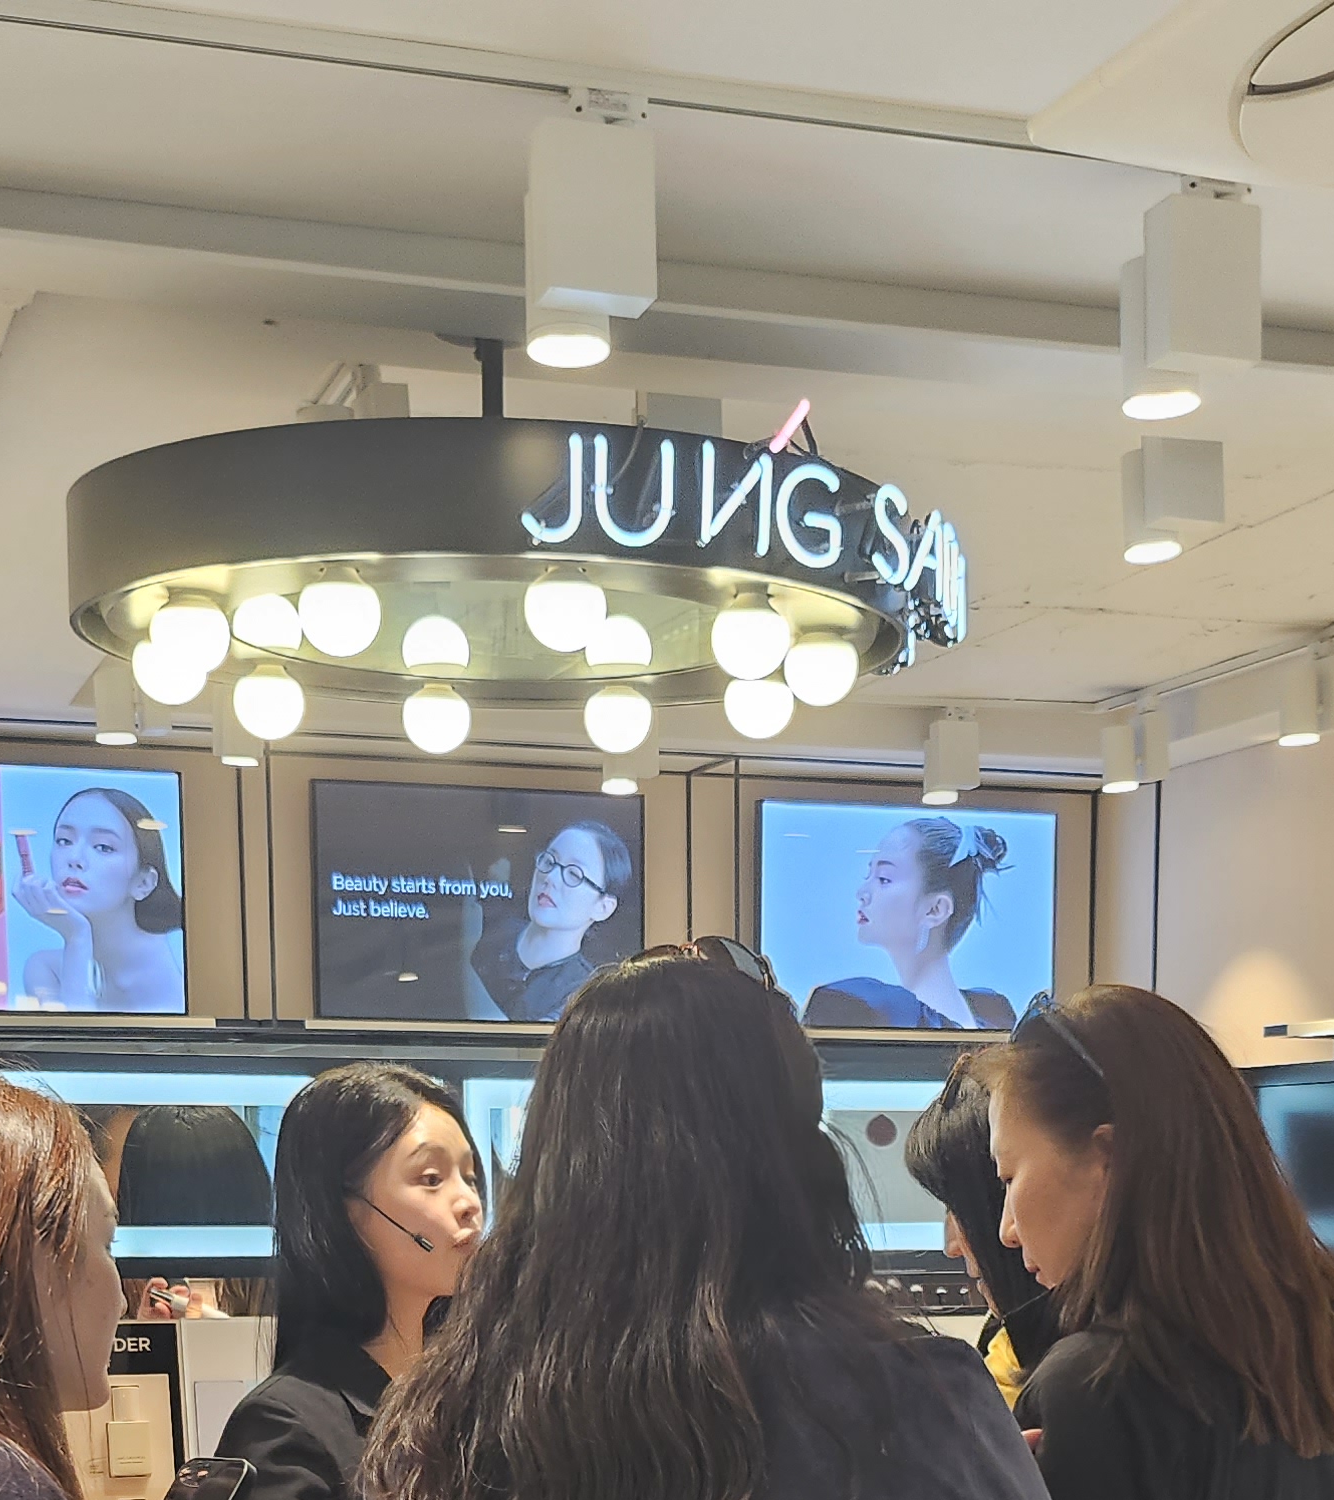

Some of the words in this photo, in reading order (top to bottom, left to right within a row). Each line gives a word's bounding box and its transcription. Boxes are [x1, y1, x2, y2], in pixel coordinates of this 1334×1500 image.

[332, 872, 388, 895] Beauty
[391, 876, 436, 894] starts
[439, 876, 476, 896] from
[332, 899, 367, 917] Just
[369, 899, 430, 919] believe.
